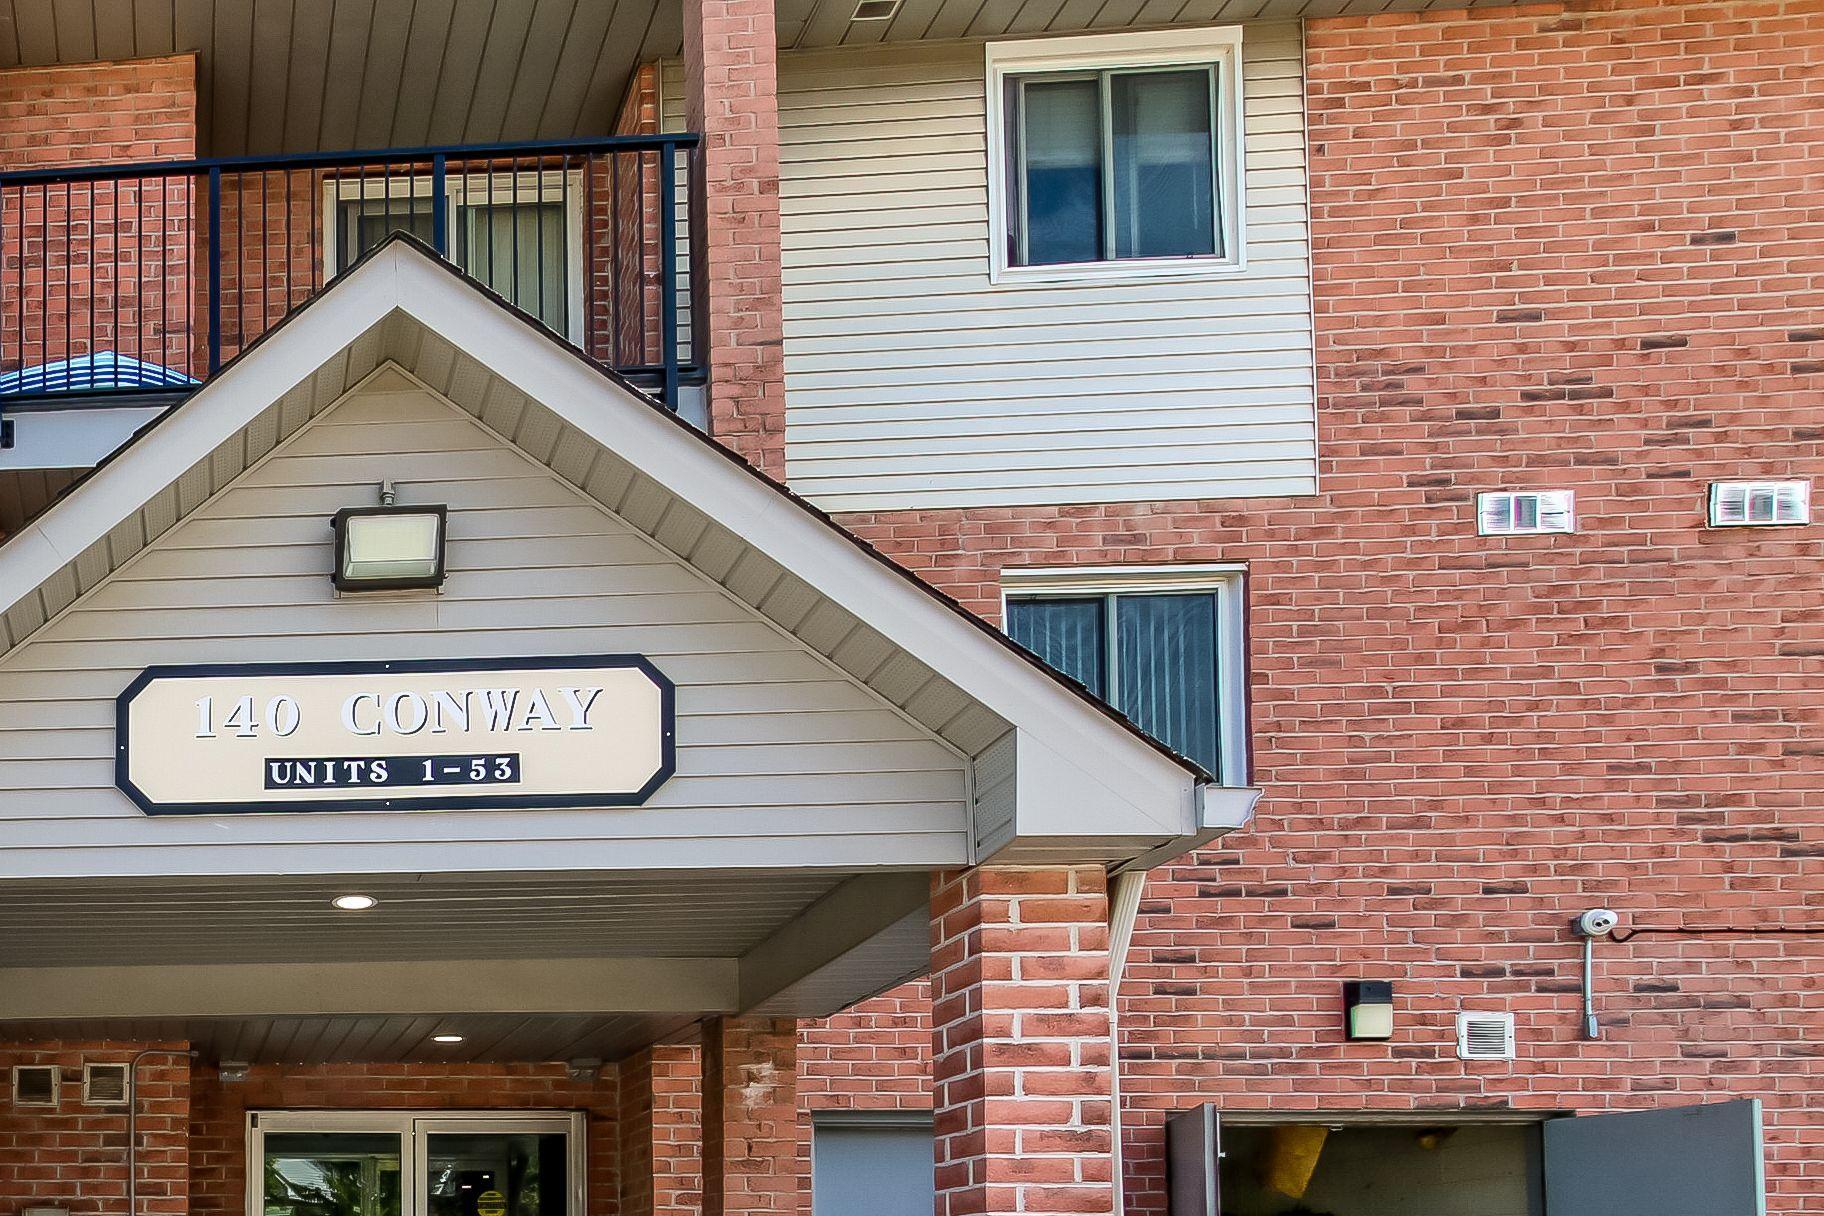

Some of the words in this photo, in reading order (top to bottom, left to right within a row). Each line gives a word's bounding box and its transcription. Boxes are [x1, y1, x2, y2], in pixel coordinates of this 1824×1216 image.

[195, 695, 300, 739] 140
[341, 687, 603, 736] CONWAY
[269, 760, 389, 784] UNITS
[422, 757, 513, 781] 1-53
